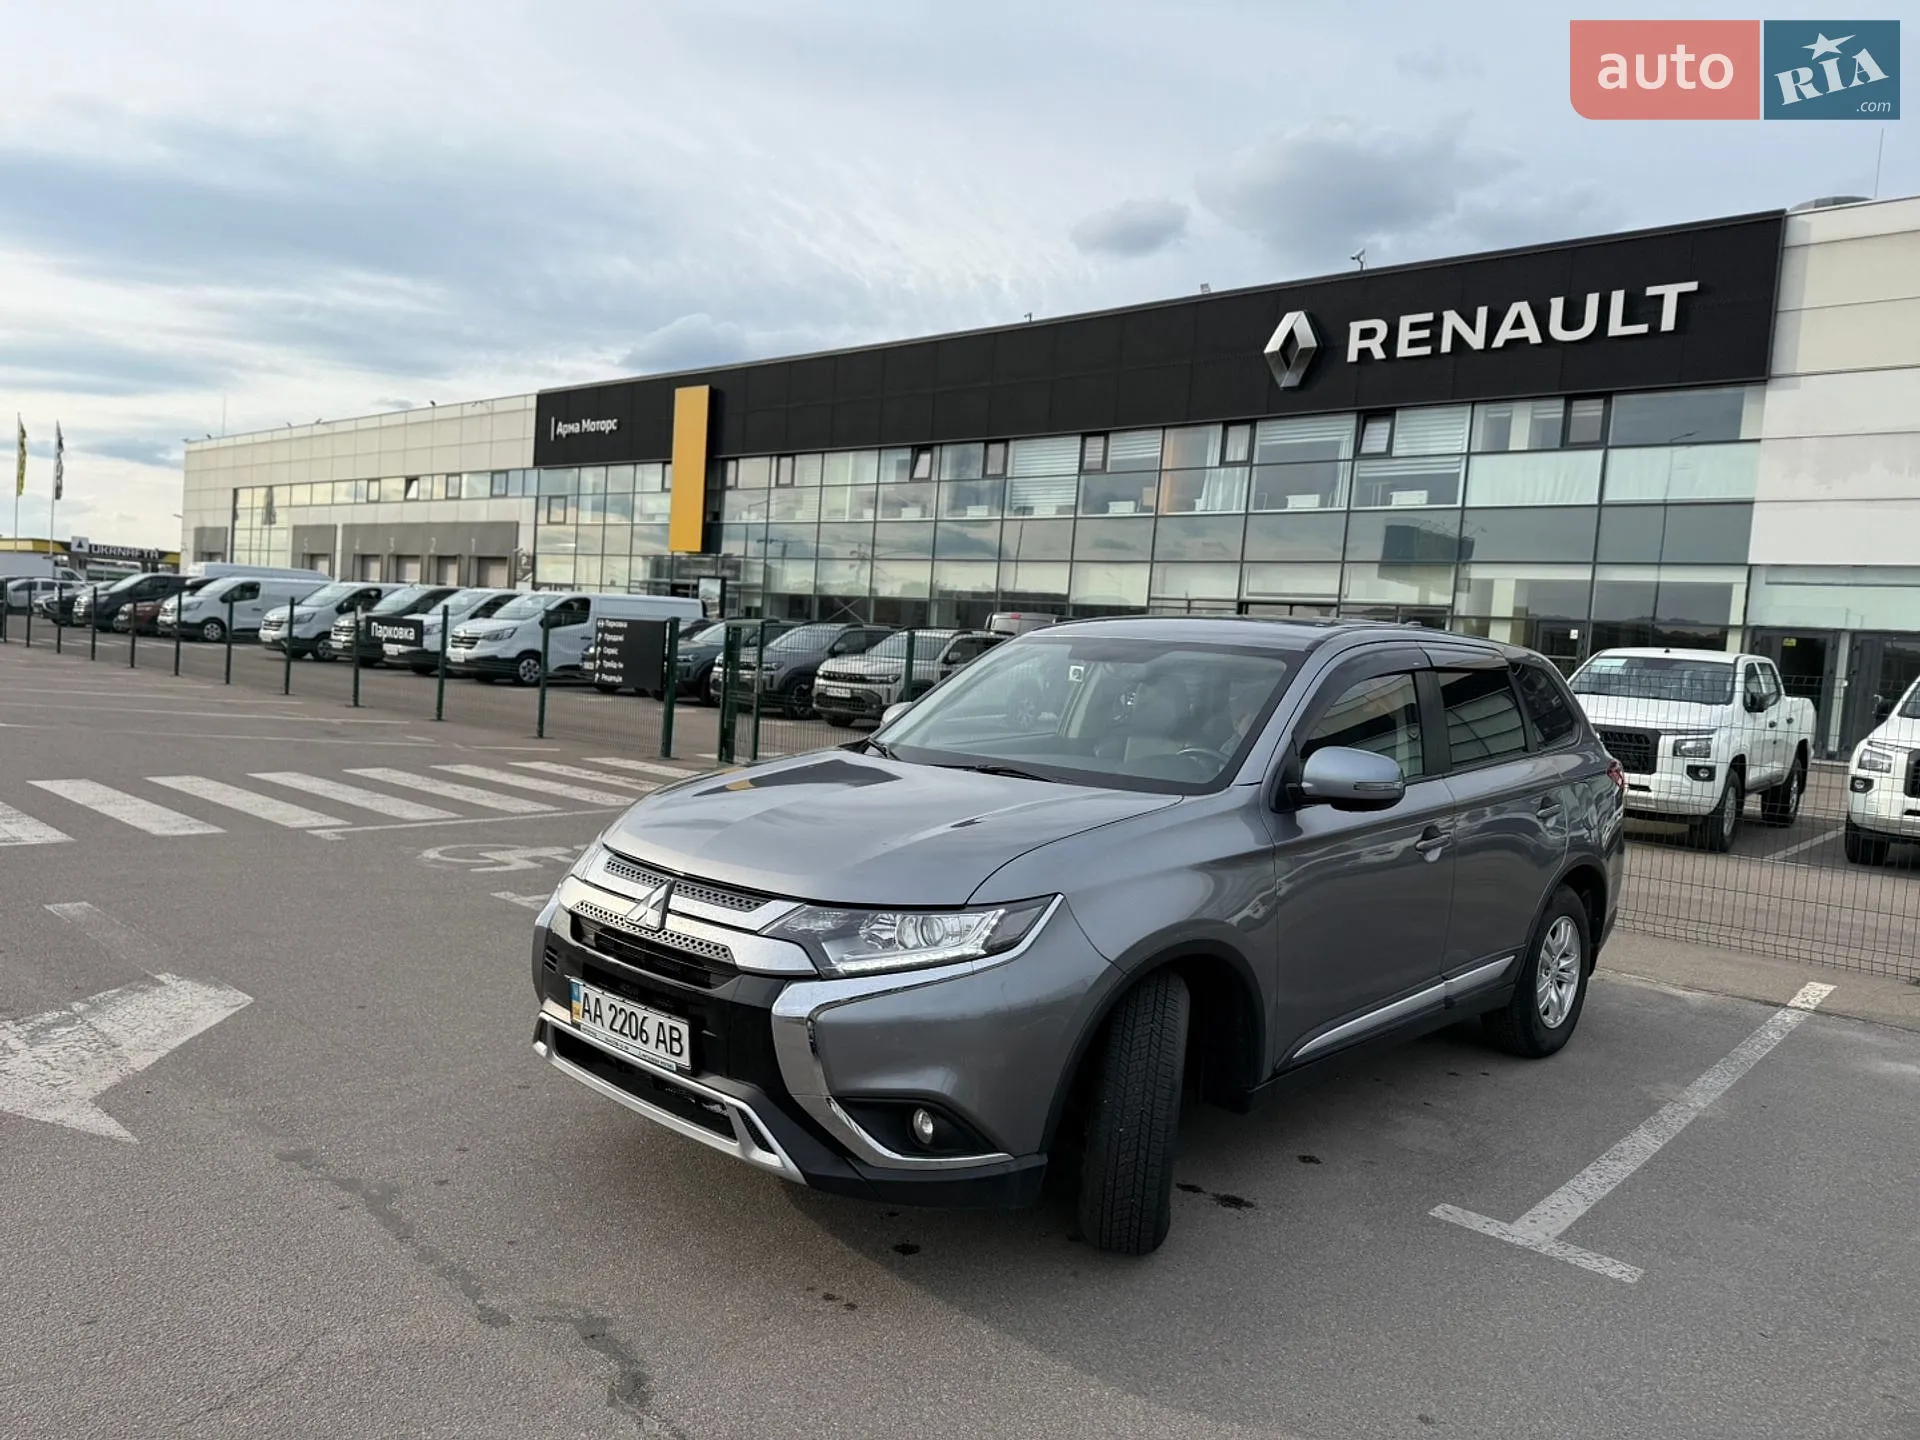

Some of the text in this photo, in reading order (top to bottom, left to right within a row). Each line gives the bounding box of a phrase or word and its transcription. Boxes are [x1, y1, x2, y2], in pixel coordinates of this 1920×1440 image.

[1346, 280, 1699, 363] RENAULT
[556, 417, 618, 437] Арма Моторс
[370, 621, 416, 642] Парковка
[581, 992, 605, 1027] AA
[608, 1002, 649, 1046] 2206
[655, 1020, 684, 1057] AB
